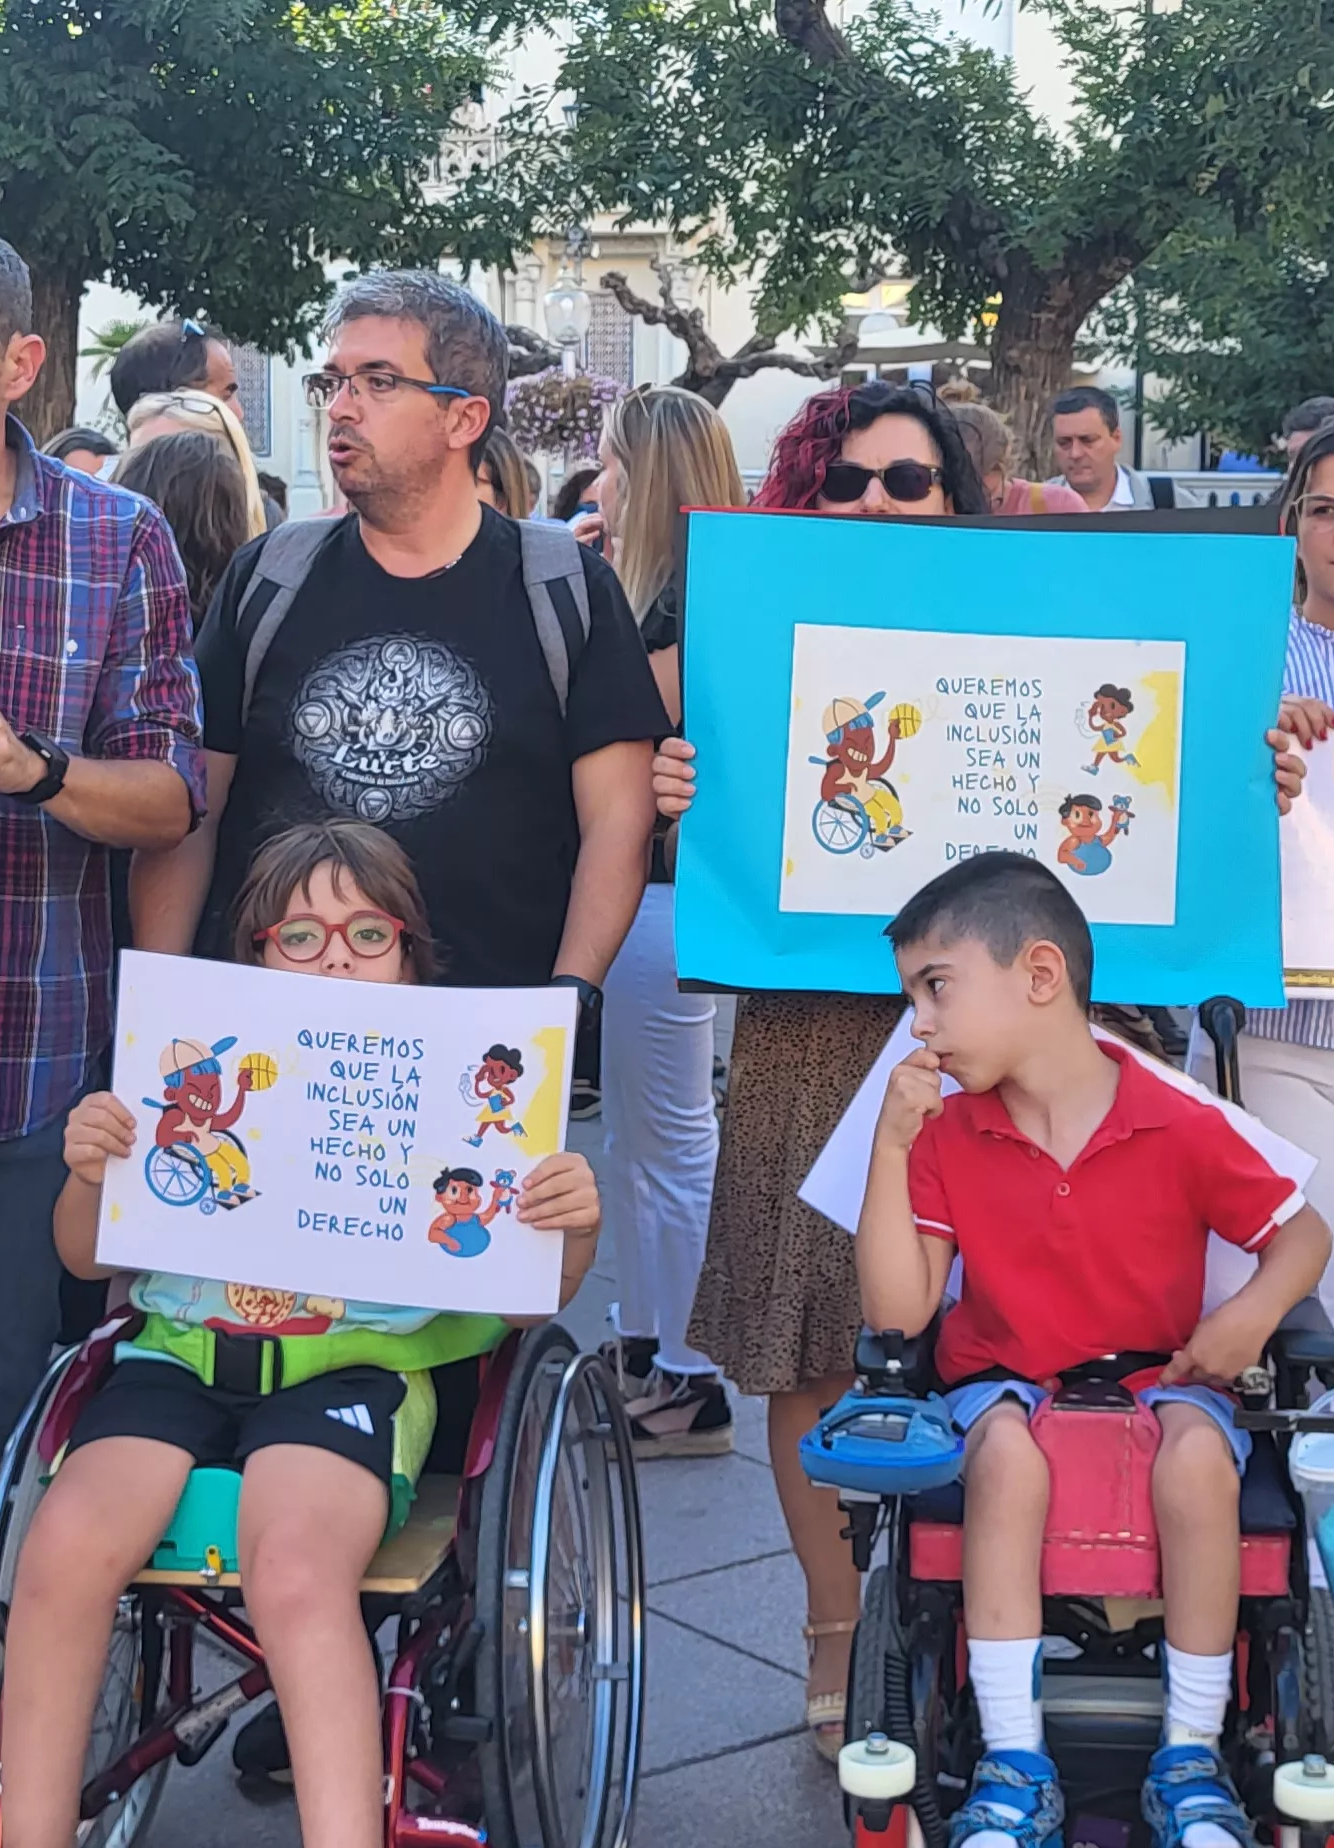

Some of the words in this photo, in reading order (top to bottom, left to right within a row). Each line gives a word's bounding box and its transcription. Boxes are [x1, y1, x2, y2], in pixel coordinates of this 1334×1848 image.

[936, 678, 1042, 698] QUEREMOS
[964, 703, 1005, 720] QUE
[1017, 703, 1041, 721] LA
[947, 724, 1041, 745] INCLUSIÓN
[967, 748, 1005, 768] SEA
[1017, 752, 1040, 768] UN
[952, 773, 1017, 792] HECHO
[1028, 773, 1040, 793] Y
[959, 798, 980, 813] NO
[993, 797, 1038, 816] SOLO
[1015, 824, 1037, 839] UN
[297, 1028, 424, 1060] QUEREMOS
[330, 1060, 379, 1082] QUE
[391, 1063, 421, 1087] LA
[306, 1081, 419, 1112] INCLUSIÓN
[328, 1109, 375, 1135] SEA
[388, 1119, 416, 1139] UN
[310, 1136, 386, 1161] HECHO
[399, 1142, 413, 1164] Y
[314, 1161, 342, 1182] NO
[355, 1164, 409, 1191] SOLO
[378, 1196, 407, 1216] UN
[298, 1208, 404, 1242] DERECHO
